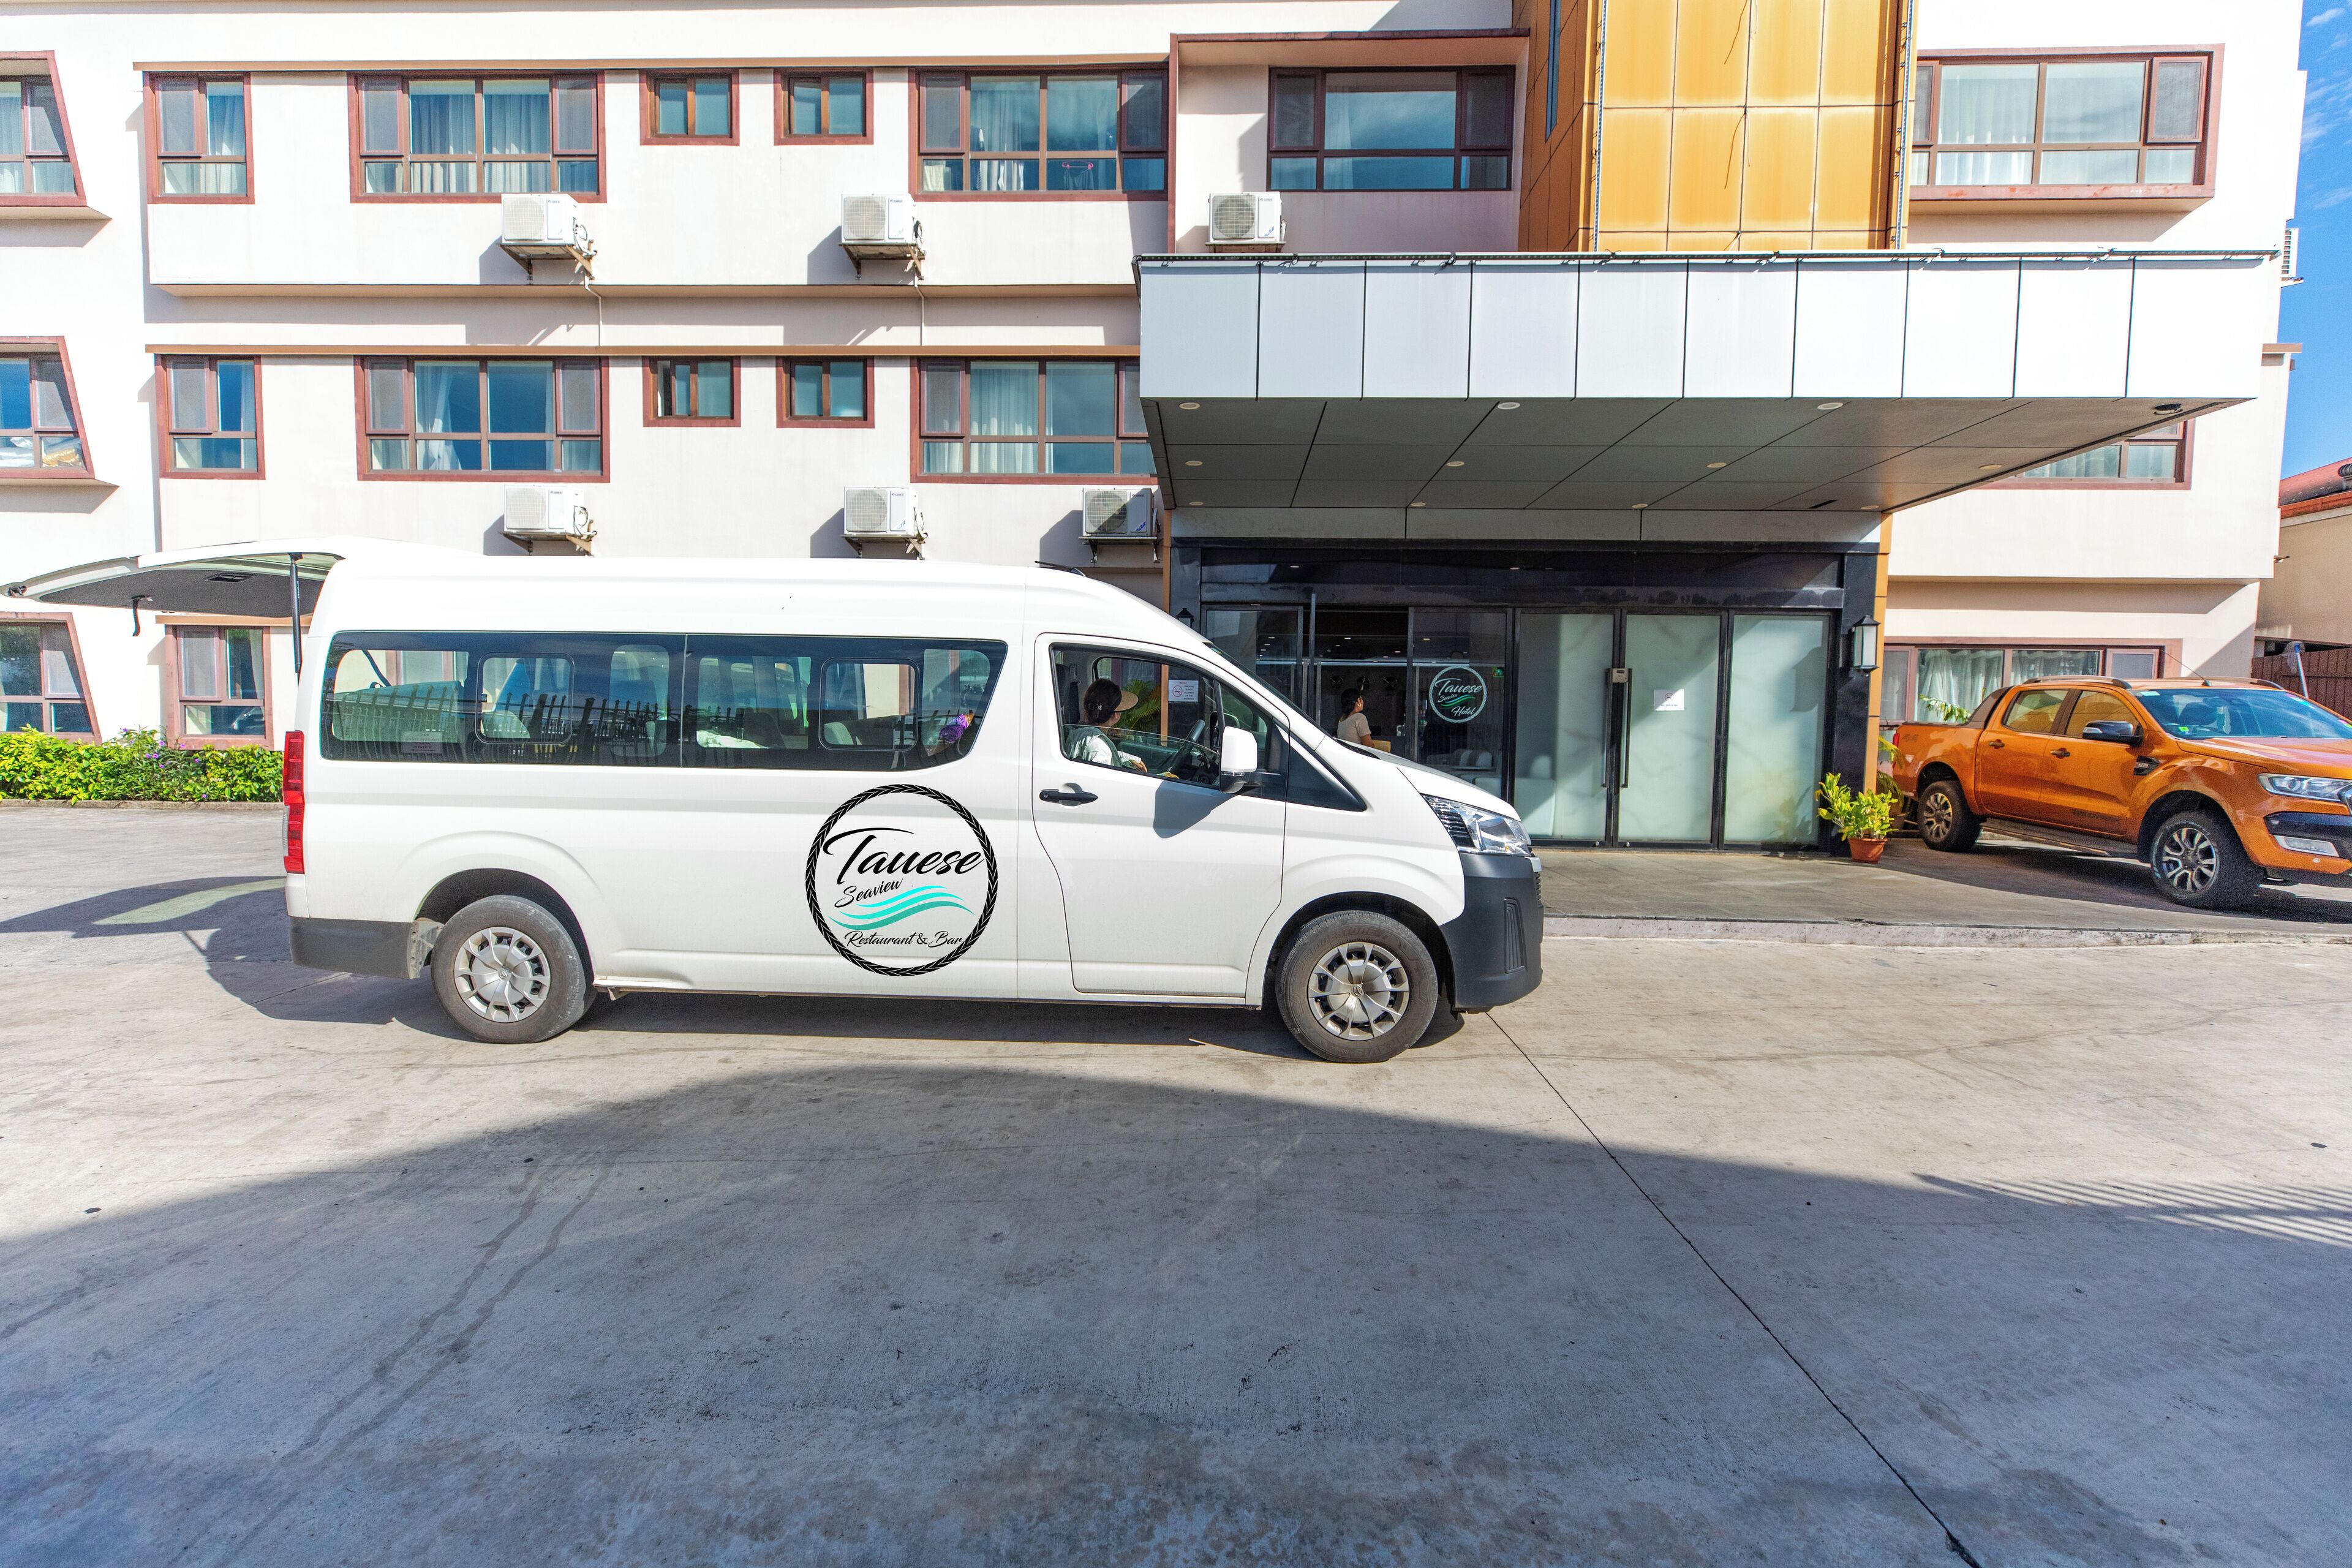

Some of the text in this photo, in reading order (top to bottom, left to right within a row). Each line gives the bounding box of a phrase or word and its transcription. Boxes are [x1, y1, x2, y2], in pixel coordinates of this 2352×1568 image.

[1434, 677, 1482, 696] Tauese
[1451, 706, 1476, 717] Hotel
[823, 827, 984, 884] Tauese
[834, 878, 903, 908] Seaview
[844, 930, 963, 948] Restaurant & Bar
